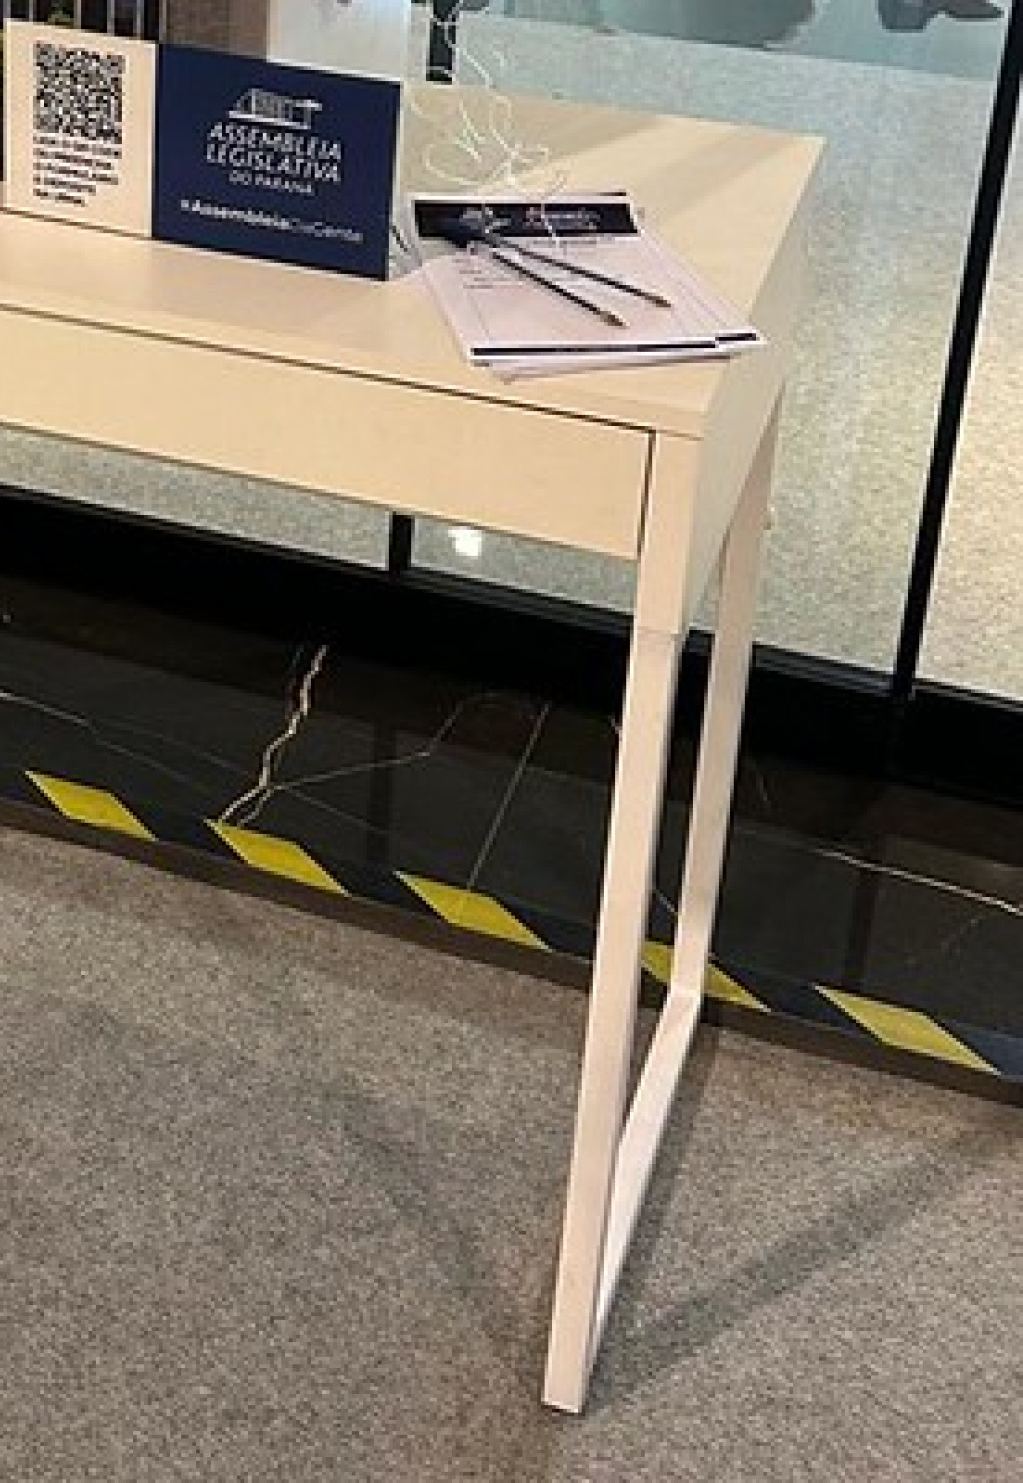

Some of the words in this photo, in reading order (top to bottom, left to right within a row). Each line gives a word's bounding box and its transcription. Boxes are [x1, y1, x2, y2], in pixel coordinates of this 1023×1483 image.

[206, 122, 342, 162] ASSEMBLEIA
[206, 143, 342, 183] LEGISLATIVA
[229, 169, 252, 186] DO
